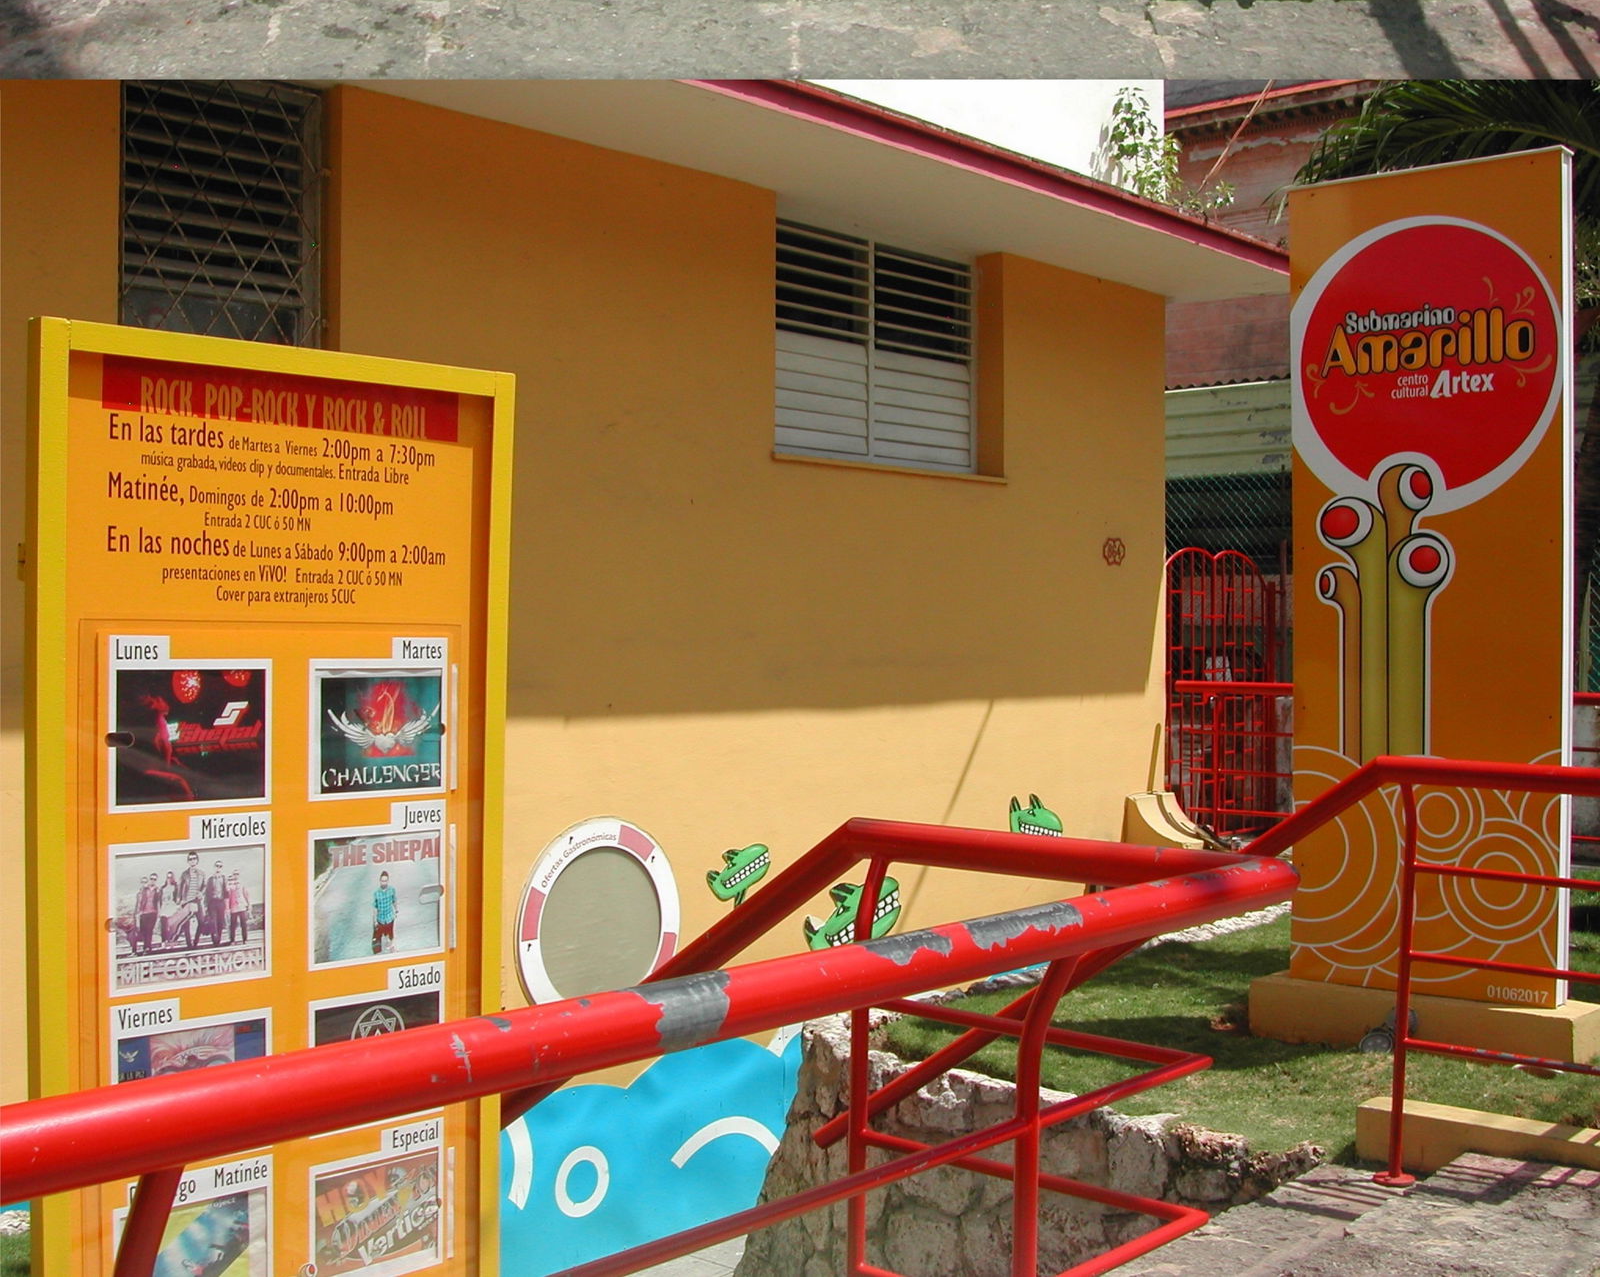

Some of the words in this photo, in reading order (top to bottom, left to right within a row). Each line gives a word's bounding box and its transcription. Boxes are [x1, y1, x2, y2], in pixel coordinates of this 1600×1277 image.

[1345, 302, 1456, 335] Submarino
[1321, 306, 1535, 378] Amarillo
[1391, 386, 1429, 399] cultural
[1397, 373, 1429, 387] centro
[1429, 369, 1495, 399] Artex
[205, 382, 299, 427] POP-ROCK
[305, 393, 317, 428] Y
[323, 395, 368, 434] ROCK
[373, 401, 384, 435] &
[391, 403, 427, 439] ROLL
[109, 413, 132, 441] En
[139, 416, 163, 443] las
[171, 421, 225, 449] tardes
[229, 435, 240, 450] de
[242, 436, 273, 453] Martes
[274, 443, 280, 453] a
[285, 440, 318, 457] Viernes
[322, 437, 371, 466] 2:00pm
[376, 448, 383, 462] a
[389, 444, 435, 471] 7:30pm
[141, 450, 174, 467] música
[177, 454, 218, 472] grabada,
[218, 456, 247, 472] videos
[249, 459, 265, 478] clip
[267, 464, 273, 478] y
[275, 461, 336, 479] documentales.
[338, 463, 380, 482] Entrada
[384, 466, 409, 485] Libre
[108, 471, 185, 506] Matinée,
[189, 485, 246, 510] Domingos
[251, 489, 264, 507] de
[269, 488, 320, 516] 2:00pm
[325, 497, 332, 511] a
[339, 492, 394, 521] 10:00pm
[204, 511, 242, 528] Entrada
[245, 514, 250, 529] 2
[253, 514, 272, 530] CUC
[282, 517, 294, 531] 50
[296, 517, 311, 531] MN
[107, 525, 130, 552] En
[139, 526, 162, 554] las
[171, 530, 230, 557] noches
[233, 540, 246, 557] de
[250, 540, 282, 559] Lunes
[285, 548, 291, 559] a
[295, 542, 334, 561] Sábado
[338, 541, 386, 569] 9:00pm
[390, 549, 397, 564] a
[401, 544, 446, 565] 2:00am
[162, 564, 241, 584] presentaciones
[243, 570, 256, 582] en
[295, 568, 334, 584] Entrada
[338, 569, 343, 585] 2
[346, 570, 364, 586] CUC
[375, 571, 386, 586] 50
[388, 571, 403, 587] MN
[216, 585, 245, 601] Cover
[248, 589, 271, 606] para
[273, 587, 329, 607] extranjeros
[331, 588, 356, 604] 5CUC
[115, 638, 159, 661] Lunes
[402, 640, 442, 660] Martes
[321, 763, 441, 788] CHALLENGER
[201, 812, 266, 840] Miércoles
[403, 805, 441, 830] Jueves
[329, 843, 368, 869] THE
[541, 858, 564, 889] Ofertas
[562, 832, 617, 858] Gastronómicas
[398, 967, 441, 990] Sábado
[1487, 985, 1549, 1003] 01062017
[118, 1005, 173, 1030] Viernes
[392, 1121, 439, 1151] Especial
[214, 1160, 268, 1188] Matinée
